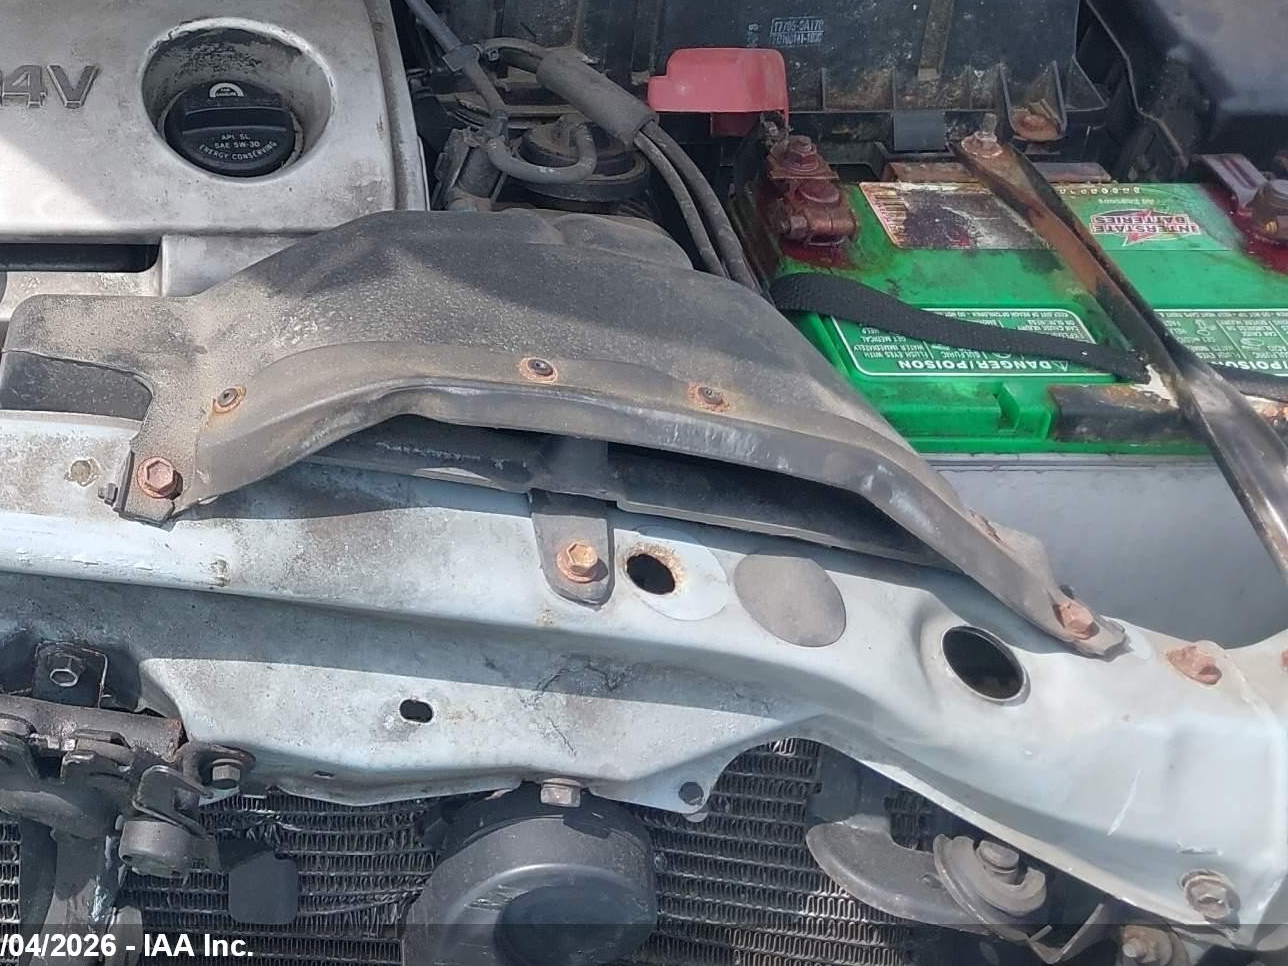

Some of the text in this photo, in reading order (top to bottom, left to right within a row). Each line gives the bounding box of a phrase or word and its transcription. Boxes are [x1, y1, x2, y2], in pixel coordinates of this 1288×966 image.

[199, 140, 278, 160] ENERGY CONSERVING
[1095, 216, 1186, 224] BATTERIES
[1094, 224, 1196, 234] INTERSTATE
[941, 351, 981, 359] SULFURIC
[898, 360, 1053, 371] DANGER/POISON
